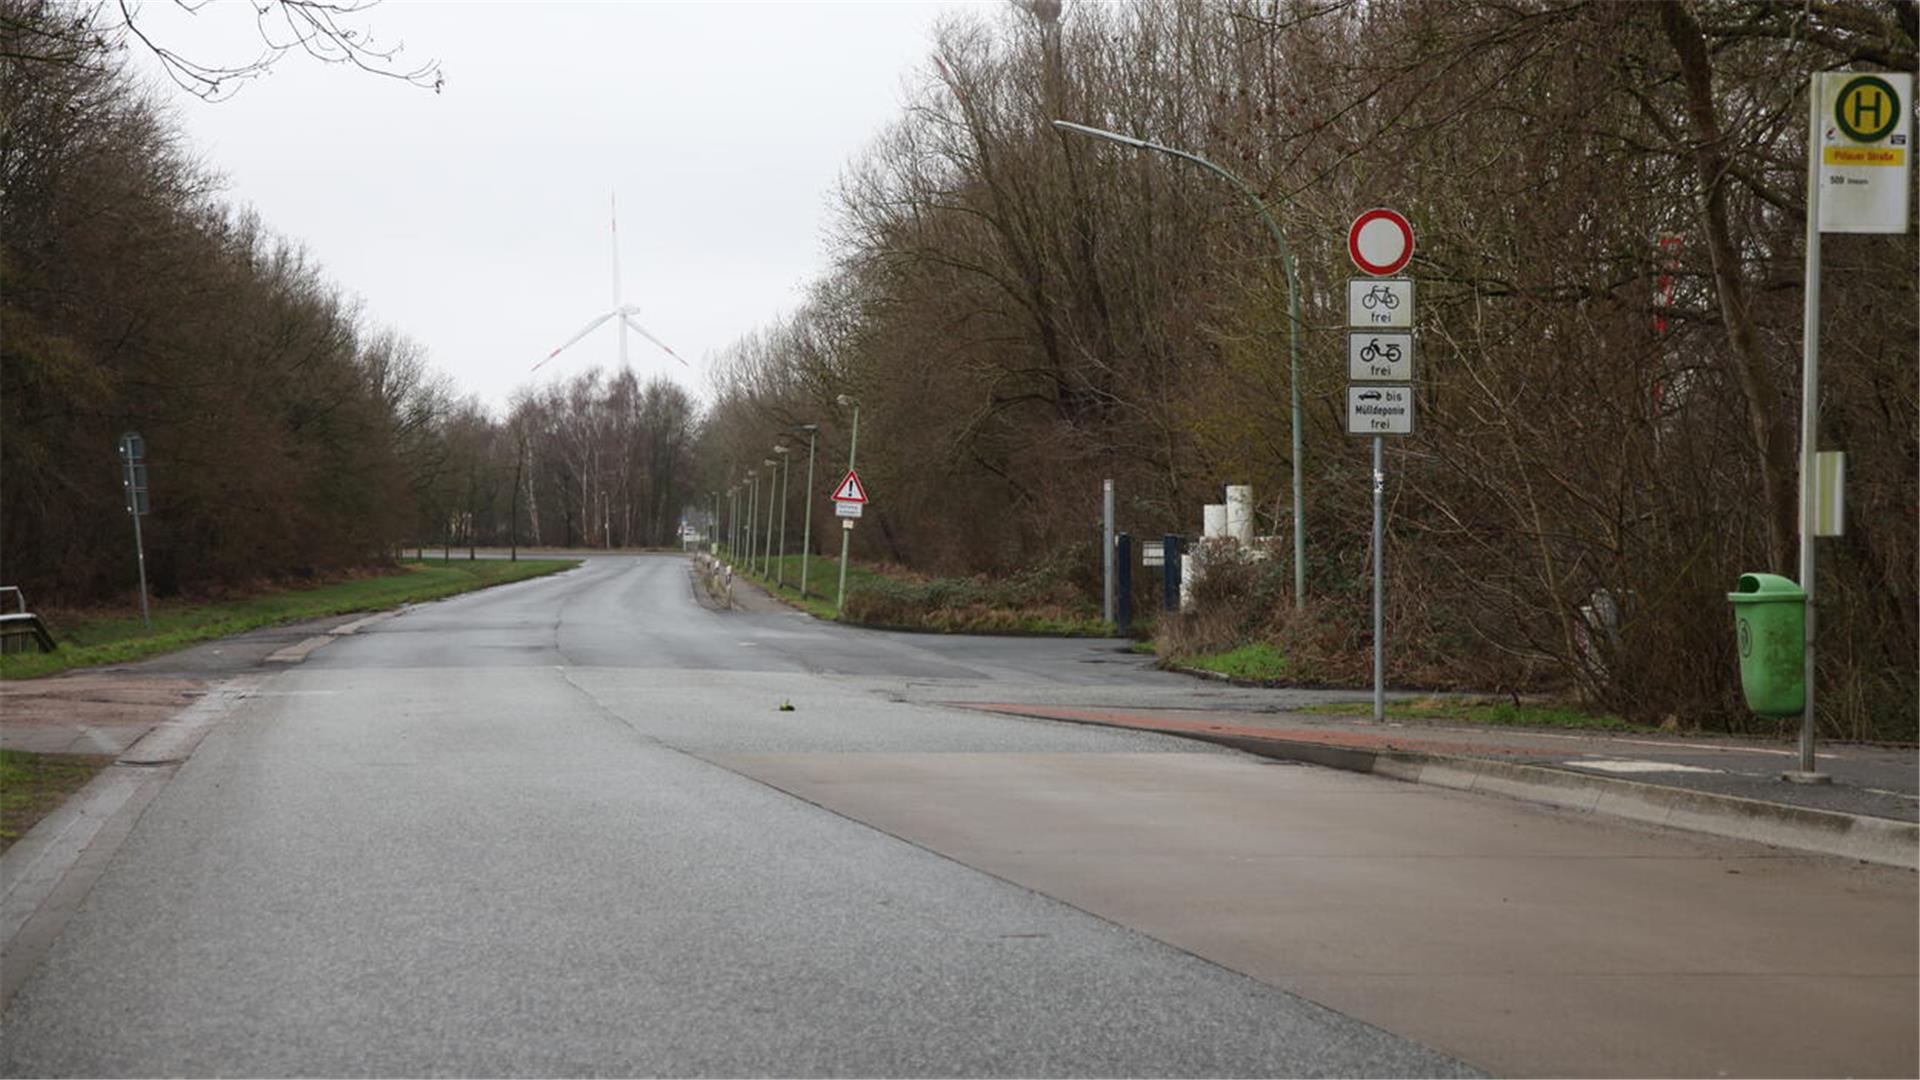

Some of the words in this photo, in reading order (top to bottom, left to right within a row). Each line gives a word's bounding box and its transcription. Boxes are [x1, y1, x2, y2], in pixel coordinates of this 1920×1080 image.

[1854, 90, 1881, 128] H
[1867, 150, 1894, 161] Straße
[1371, 311, 1392, 323] frei
[1371, 365, 1391, 376] frei
[1386, 390, 1402, 401] bis
[1355, 404, 1405, 416] Mülldeponie
[1371, 419, 1390, 430] frei
